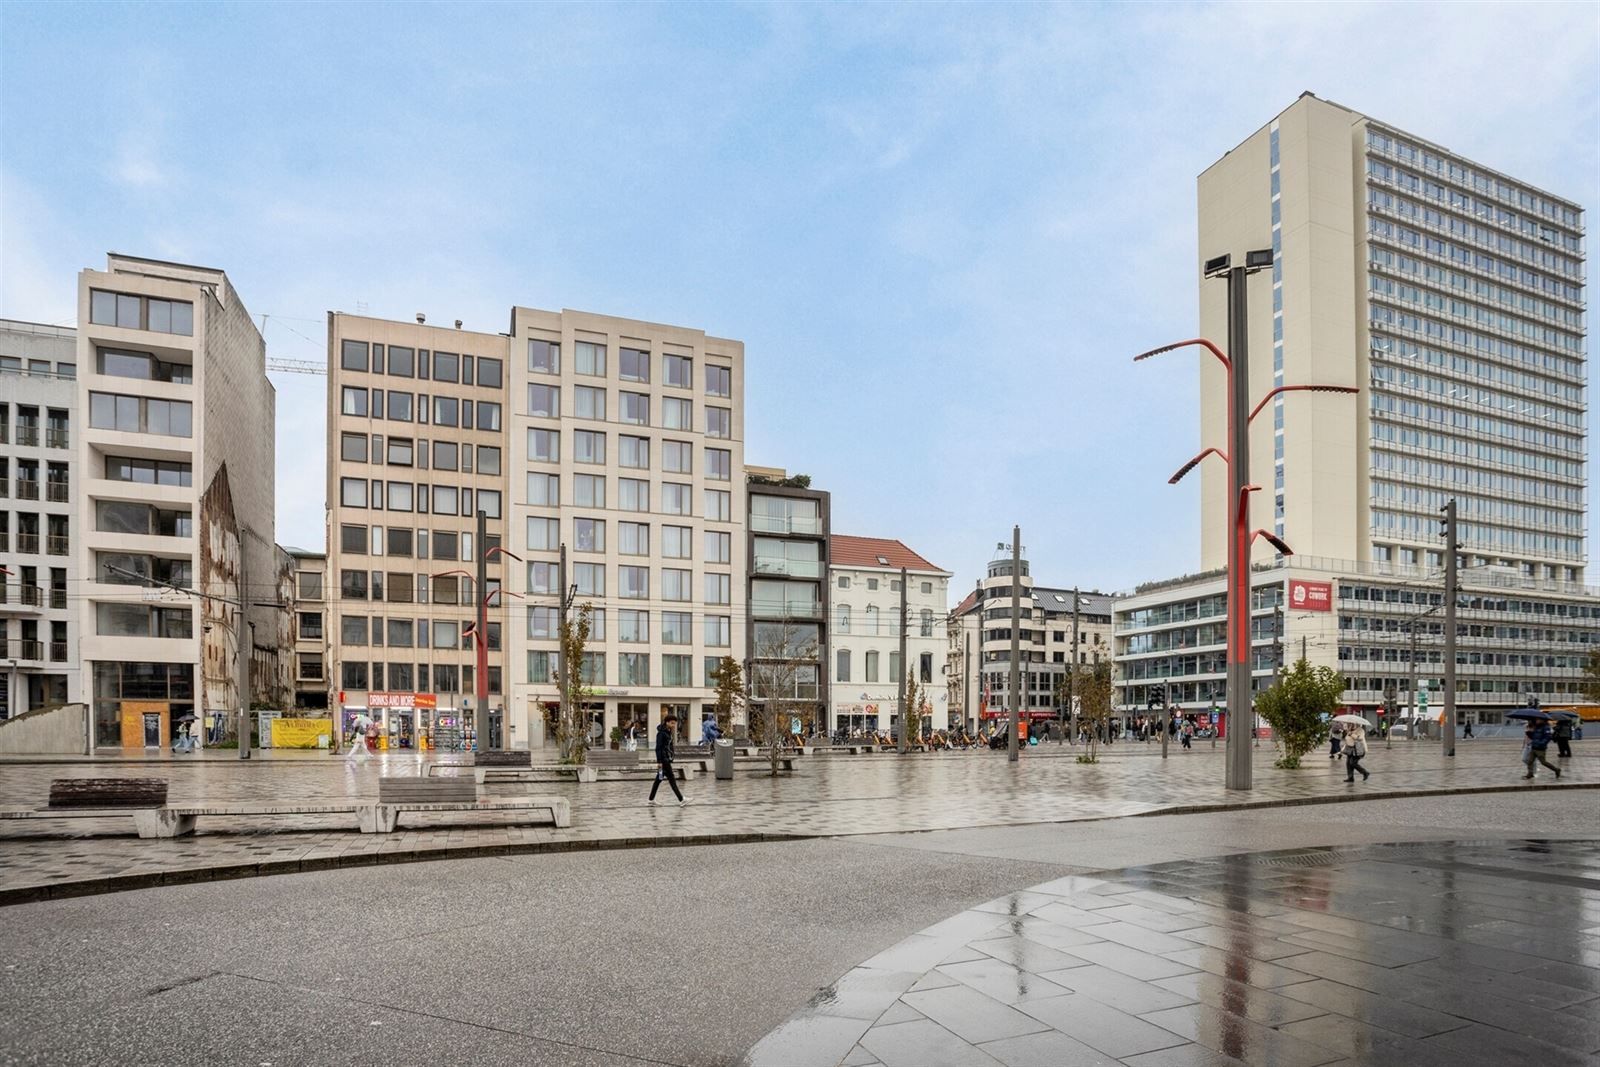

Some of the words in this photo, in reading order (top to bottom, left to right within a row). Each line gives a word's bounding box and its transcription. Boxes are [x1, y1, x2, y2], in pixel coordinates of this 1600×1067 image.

[369, 694, 388, 706] DRINKS
[389, 695, 400, 706] AND
[400, 695, 415, 706] MORE
